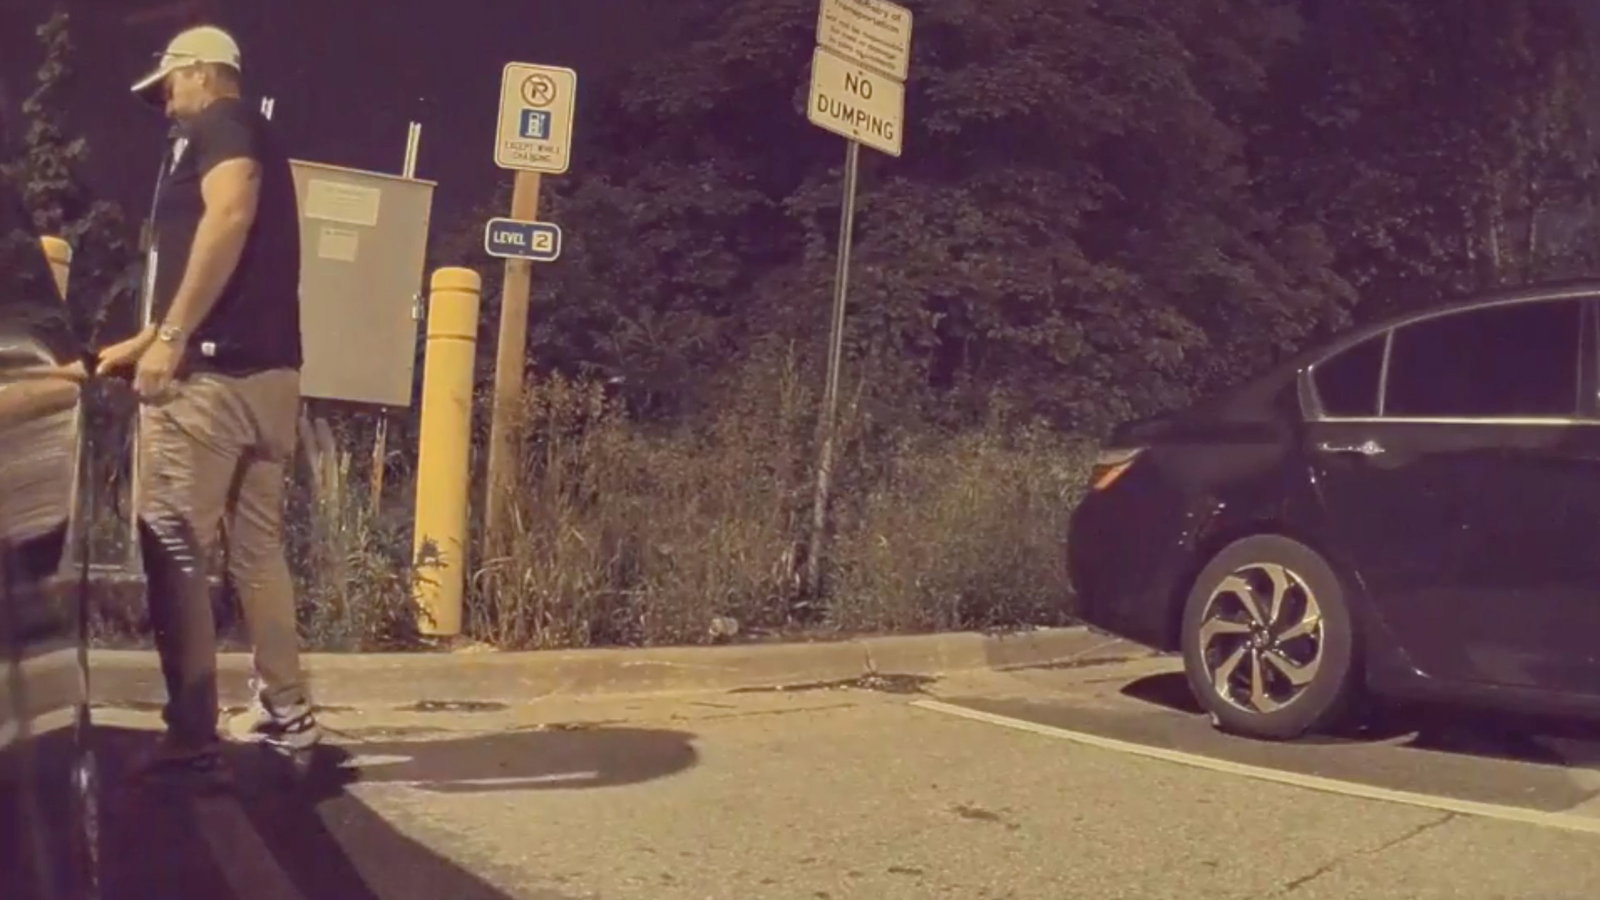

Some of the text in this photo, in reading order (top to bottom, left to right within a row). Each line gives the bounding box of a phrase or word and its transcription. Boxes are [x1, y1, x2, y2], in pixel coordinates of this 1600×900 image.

[844, 71, 873, 100] NO
[817, 93, 894, 140] DUMPING
[493, 230, 548, 248] LEVEL 2
